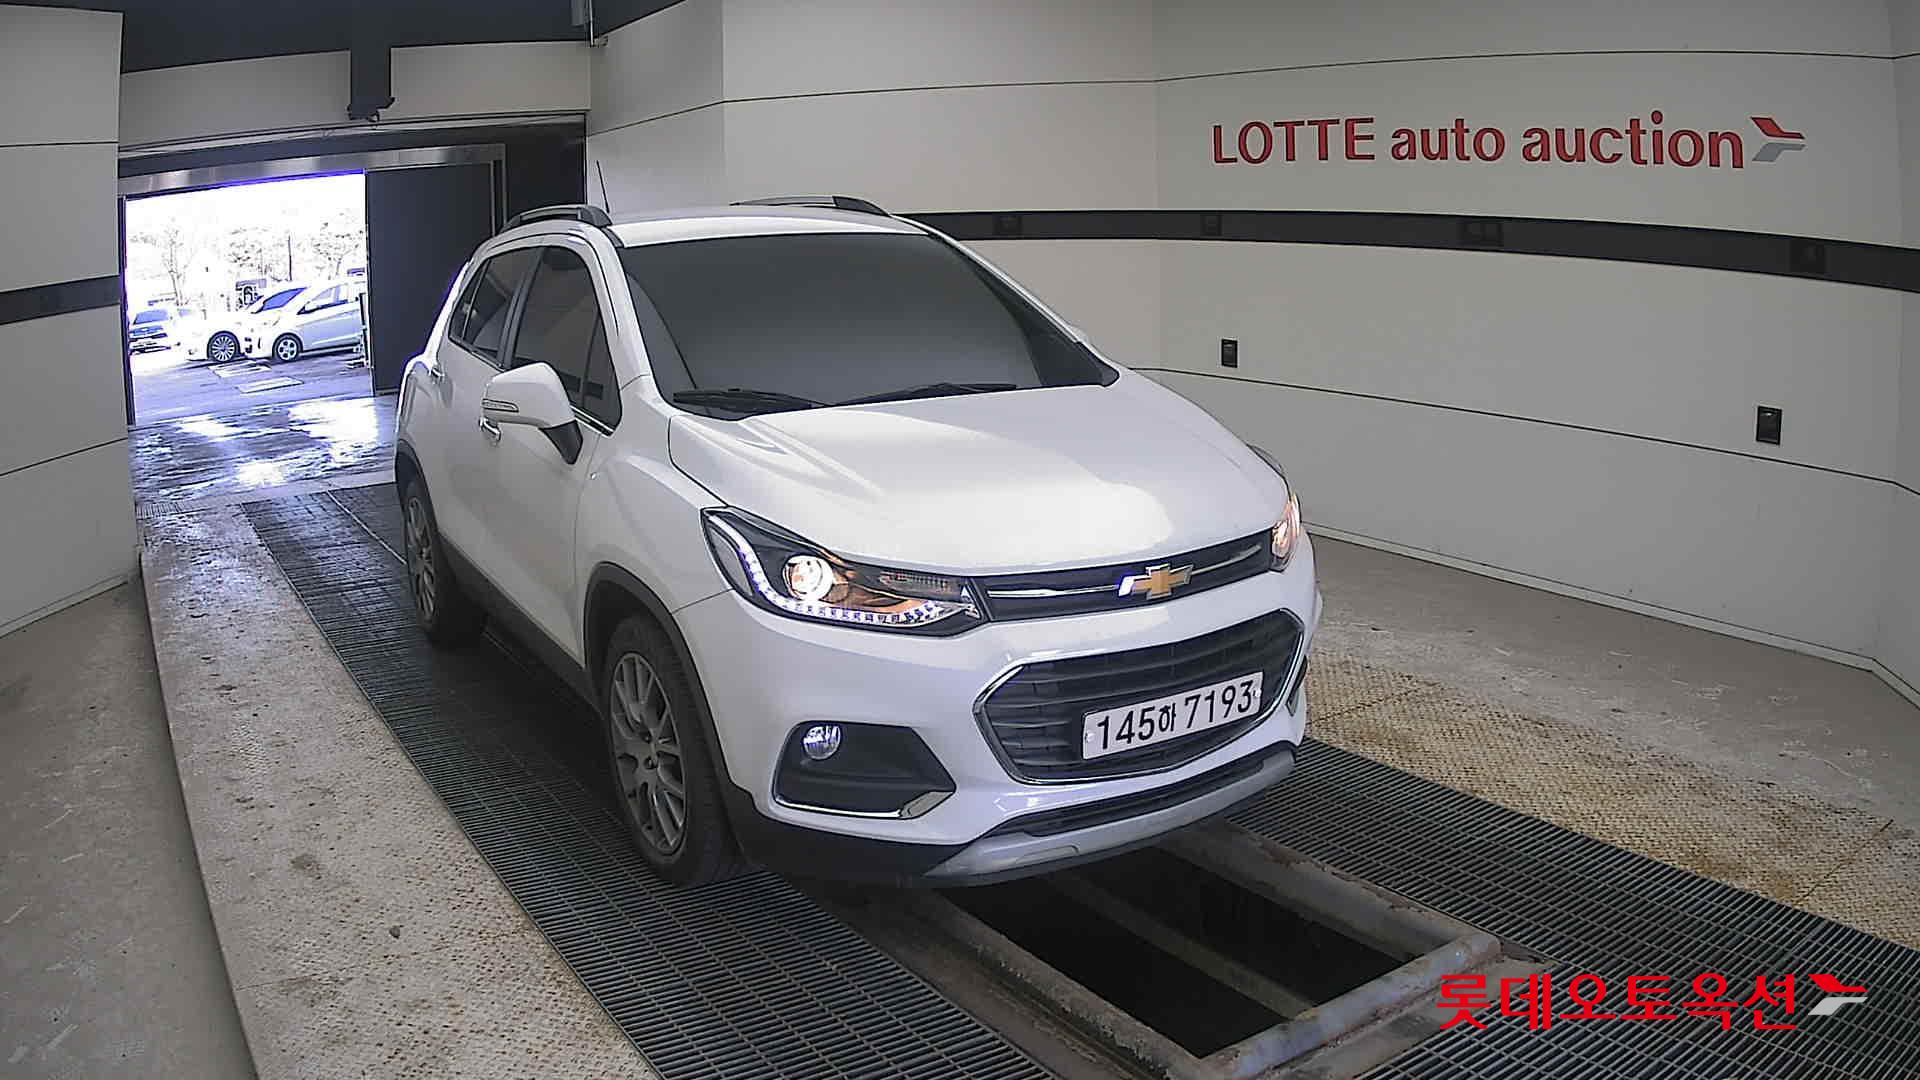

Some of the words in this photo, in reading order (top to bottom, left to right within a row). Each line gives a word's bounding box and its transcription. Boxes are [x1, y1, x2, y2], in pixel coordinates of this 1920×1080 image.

[1212, 117, 1376, 164] LOTTE
[1391, 118, 1505, 162] auto
[1521, 110, 1744, 169] auction
[1097, 703, 1176, 749] 145하
[1184, 680, 1254, 729] 7193
